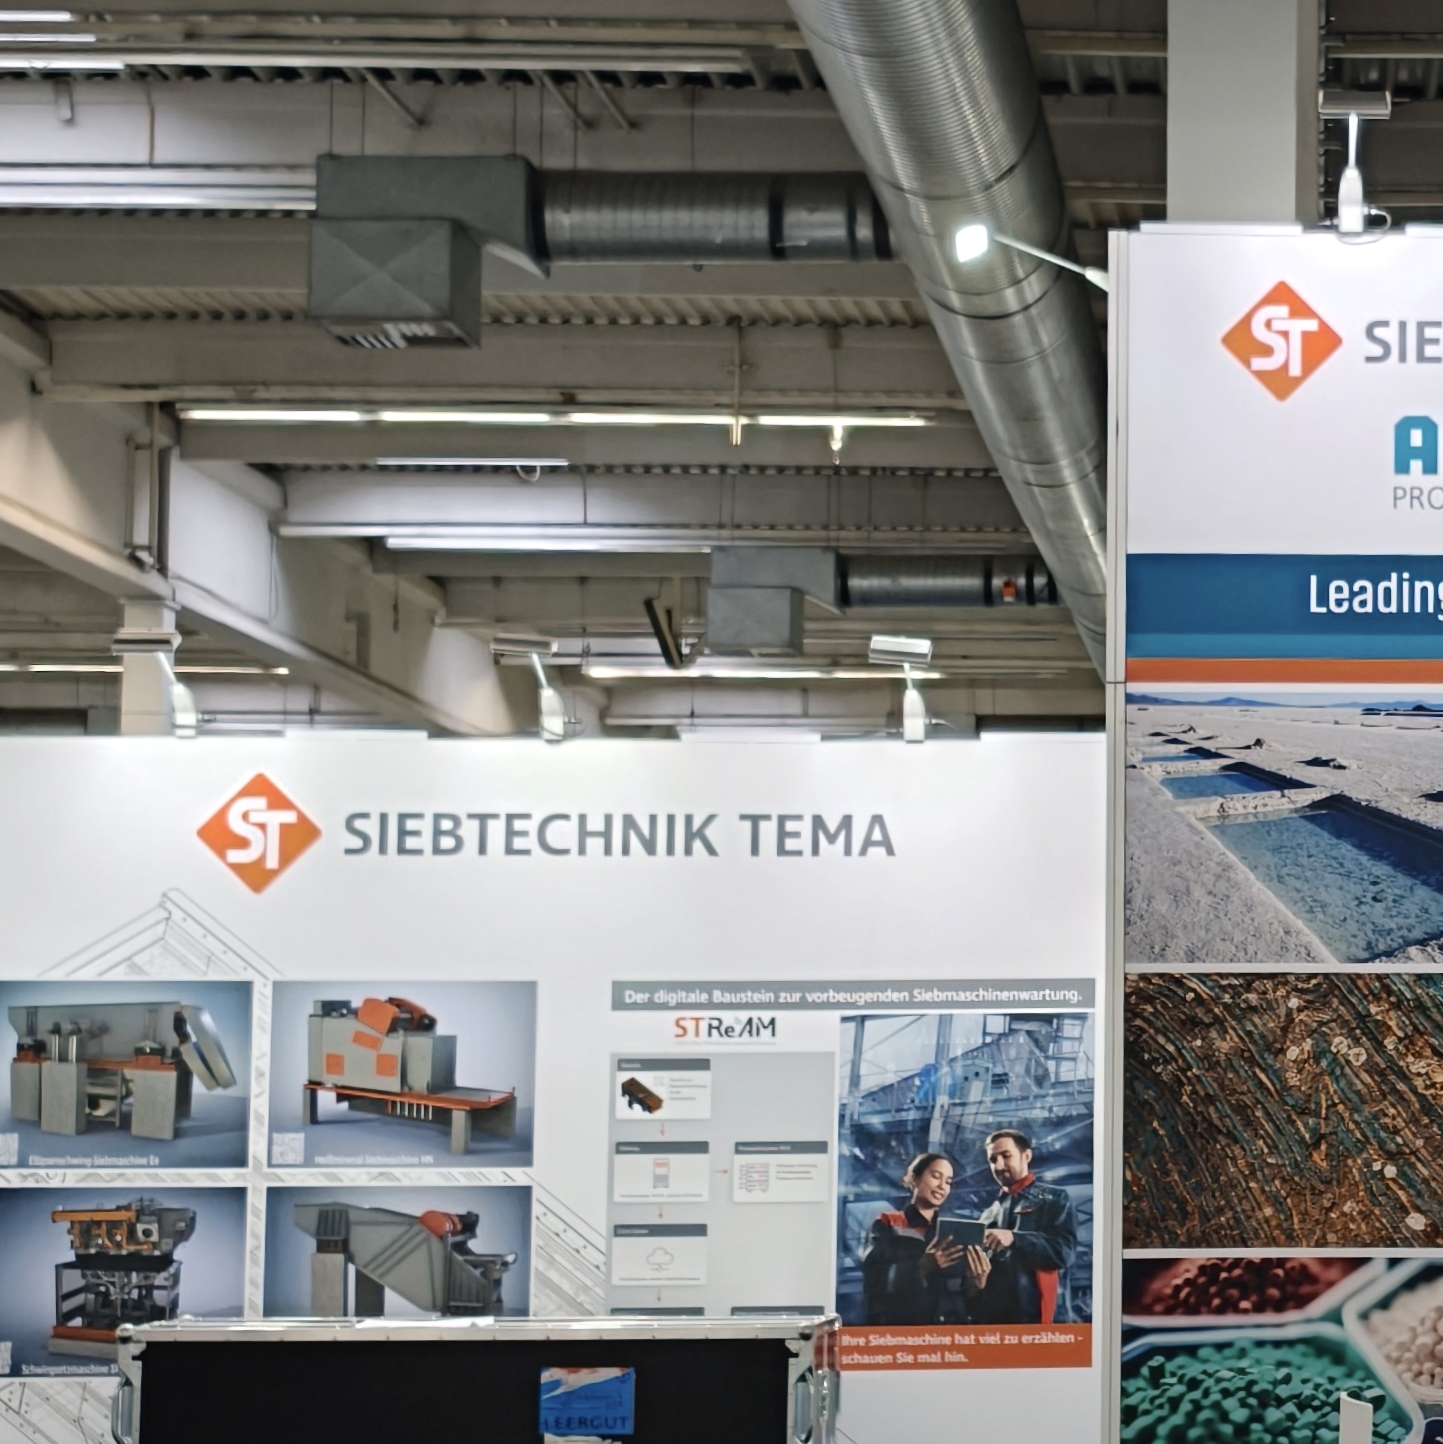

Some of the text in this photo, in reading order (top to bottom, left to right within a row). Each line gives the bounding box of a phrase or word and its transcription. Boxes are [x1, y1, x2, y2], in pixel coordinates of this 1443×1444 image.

[343, 812, 720, 857] SIEBTECHNIK
[739, 812, 897, 858] TEMA
[625, 988, 1082, 1007] Der digitale Baustein zur vorbeugenden Siebmaschinenwartung.
[842, 1335, 866, 1346] Ihre
[869, 1333, 952, 1346] Siebmaschine
[955, 1333, 975, 1345] hat
[979, 1333, 1000, 1345] viel
[1003, 1334, 1018, 1344] zu
[1021, 1332, 1074, 1344] erzählen
[841, 1351, 968, 1364] schauen Sie mal hin.
